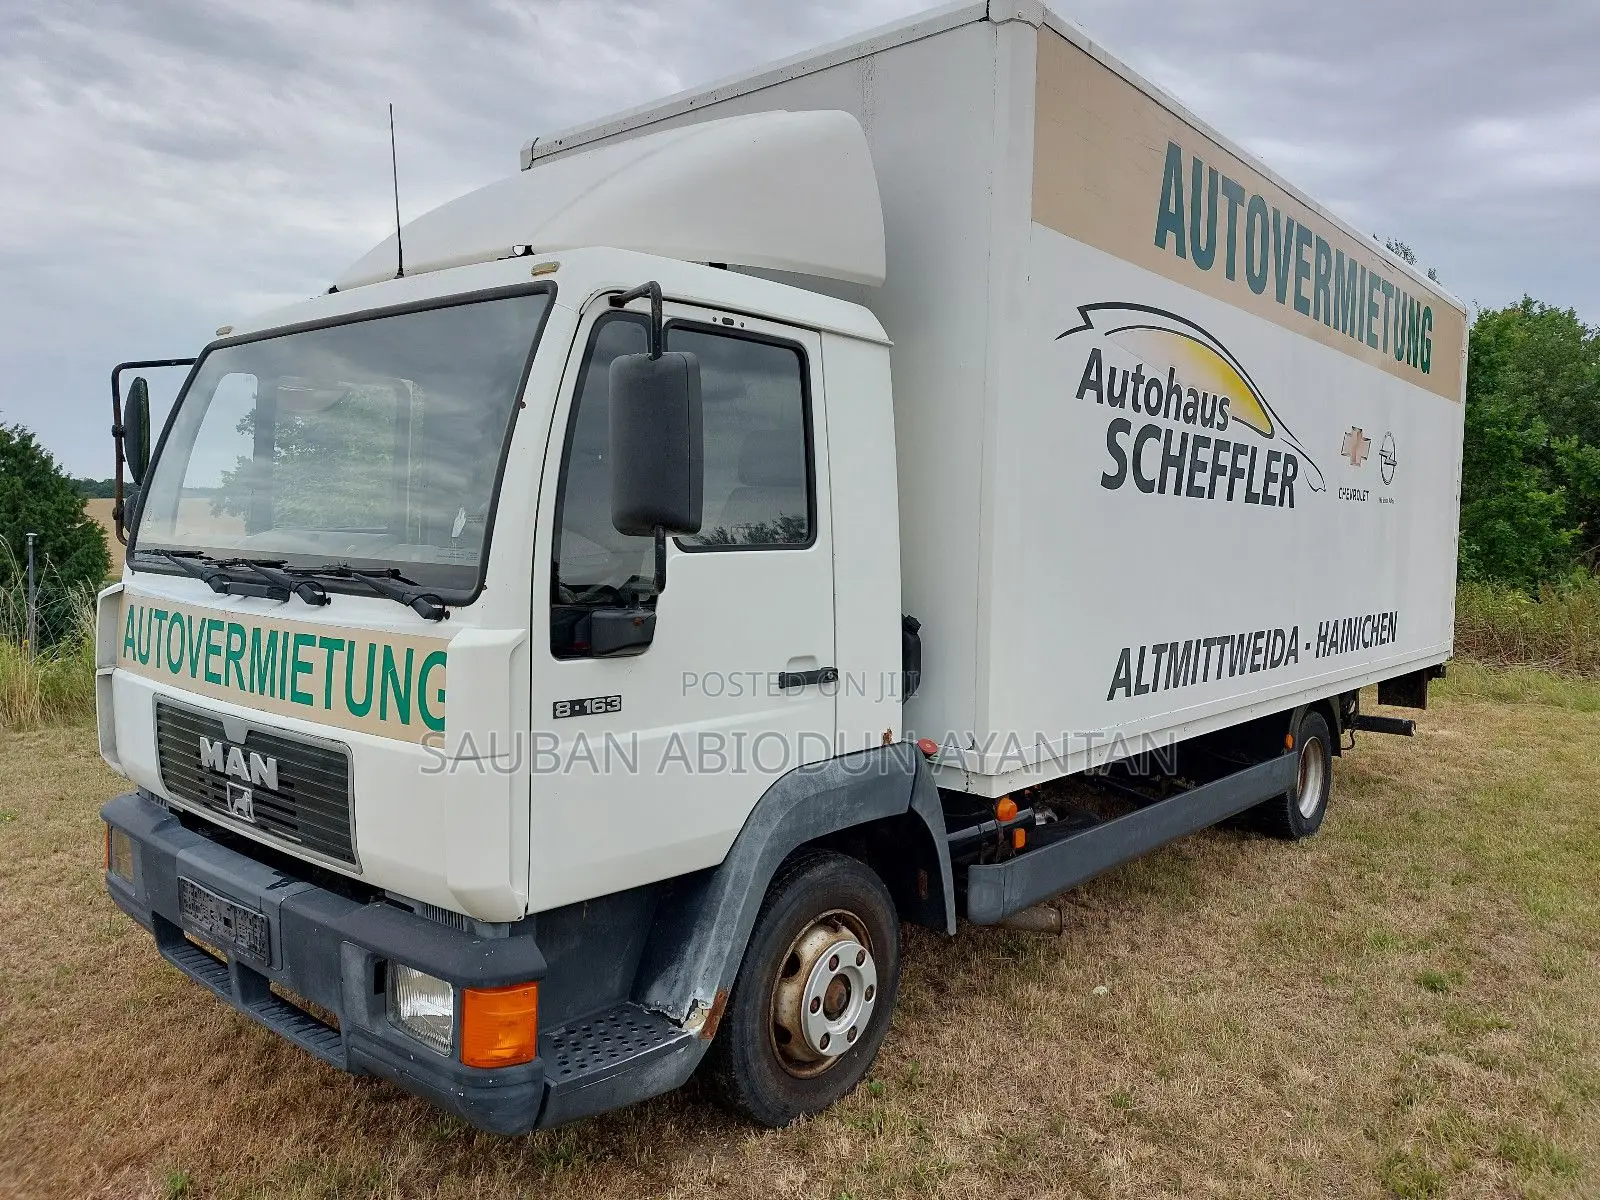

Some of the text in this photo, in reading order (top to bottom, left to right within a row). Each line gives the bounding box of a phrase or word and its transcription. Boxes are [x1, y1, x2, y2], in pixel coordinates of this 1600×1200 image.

[1154, 140, 1432, 374] AUTOVERMIETUNG
[1076, 347, 1230, 431] Autohaus
[1100, 417, 1298, 508] SCHEFFLER
[1338, 487, 1370, 502] CHEVROLET
[123, 604, 447, 732] AUTOVERMIETUNG
[1106, 626, 1299, 701] ALTMITTWEIDA
[1315, 611, 1399, 659] HAINICHEN
[199, 736, 279, 791] MAN
